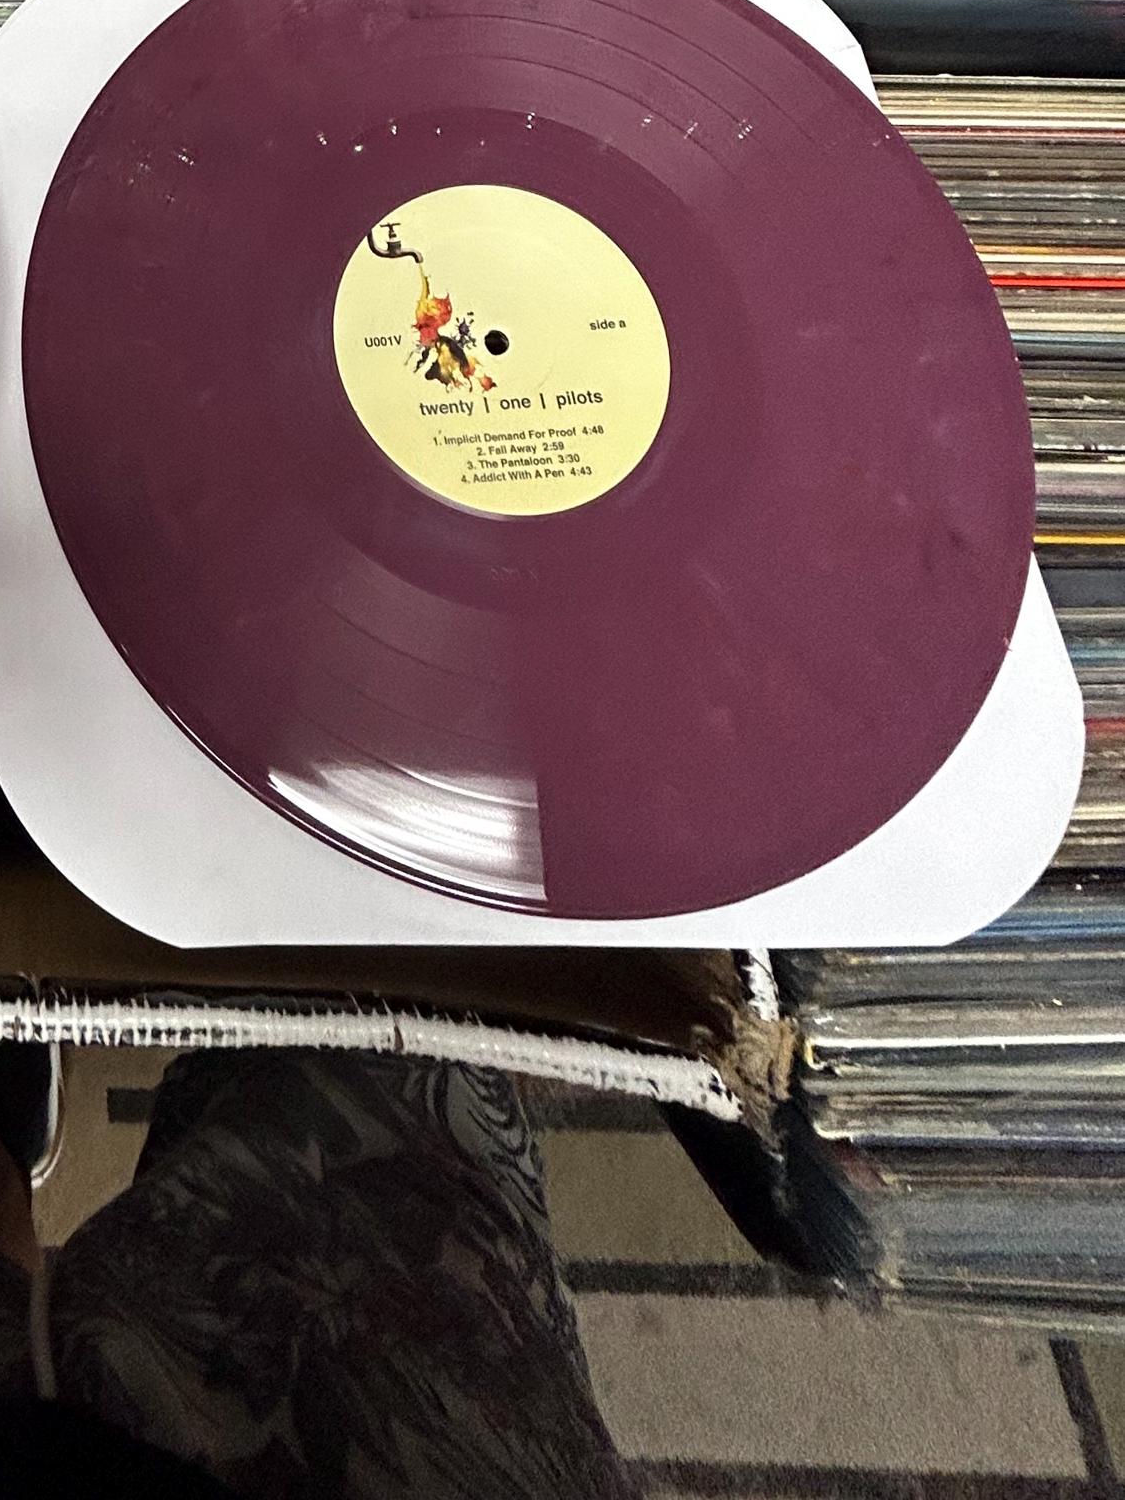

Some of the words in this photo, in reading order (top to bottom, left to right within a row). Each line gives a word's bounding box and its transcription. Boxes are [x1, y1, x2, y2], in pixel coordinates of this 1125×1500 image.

[589, 319, 618, 331] side
[618, 319, 627, 328] a
[364, 334, 402, 349] U001V
[419, 399, 475, 417] twenty
[499, 394, 532, 411] one
[555, 390, 604, 411] pilots
[433, 436, 443, 446] 1.
[443, 431, 483, 447] Implicit
[483, 429, 527, 444] Demand
[528, 428, 546, 440] For
[548, 426, 577, 440] Proof
[582, 424, 605, 436] 4:48
[475, 446, 487, 457] 2.
[488, 444, 508, 456] Fall
[509, 443, 538, 456] Away
[542, 440, 565, 452] 2:59
[466, 460, 477, 471] 3.
[478, 458, 499, 470] The
[500, 454, 554, 469] Pantaloon
[558, 453, 581, 465] 3:30
[460, 474, 472, 485] 4.
[472, 471, 508, 484] Addict
[508, 469, 533, 481] With
[534, 468, 544, 480] A
[544, 467, 565, 479] Pen
[570, 465, 593, 477] 4:43
